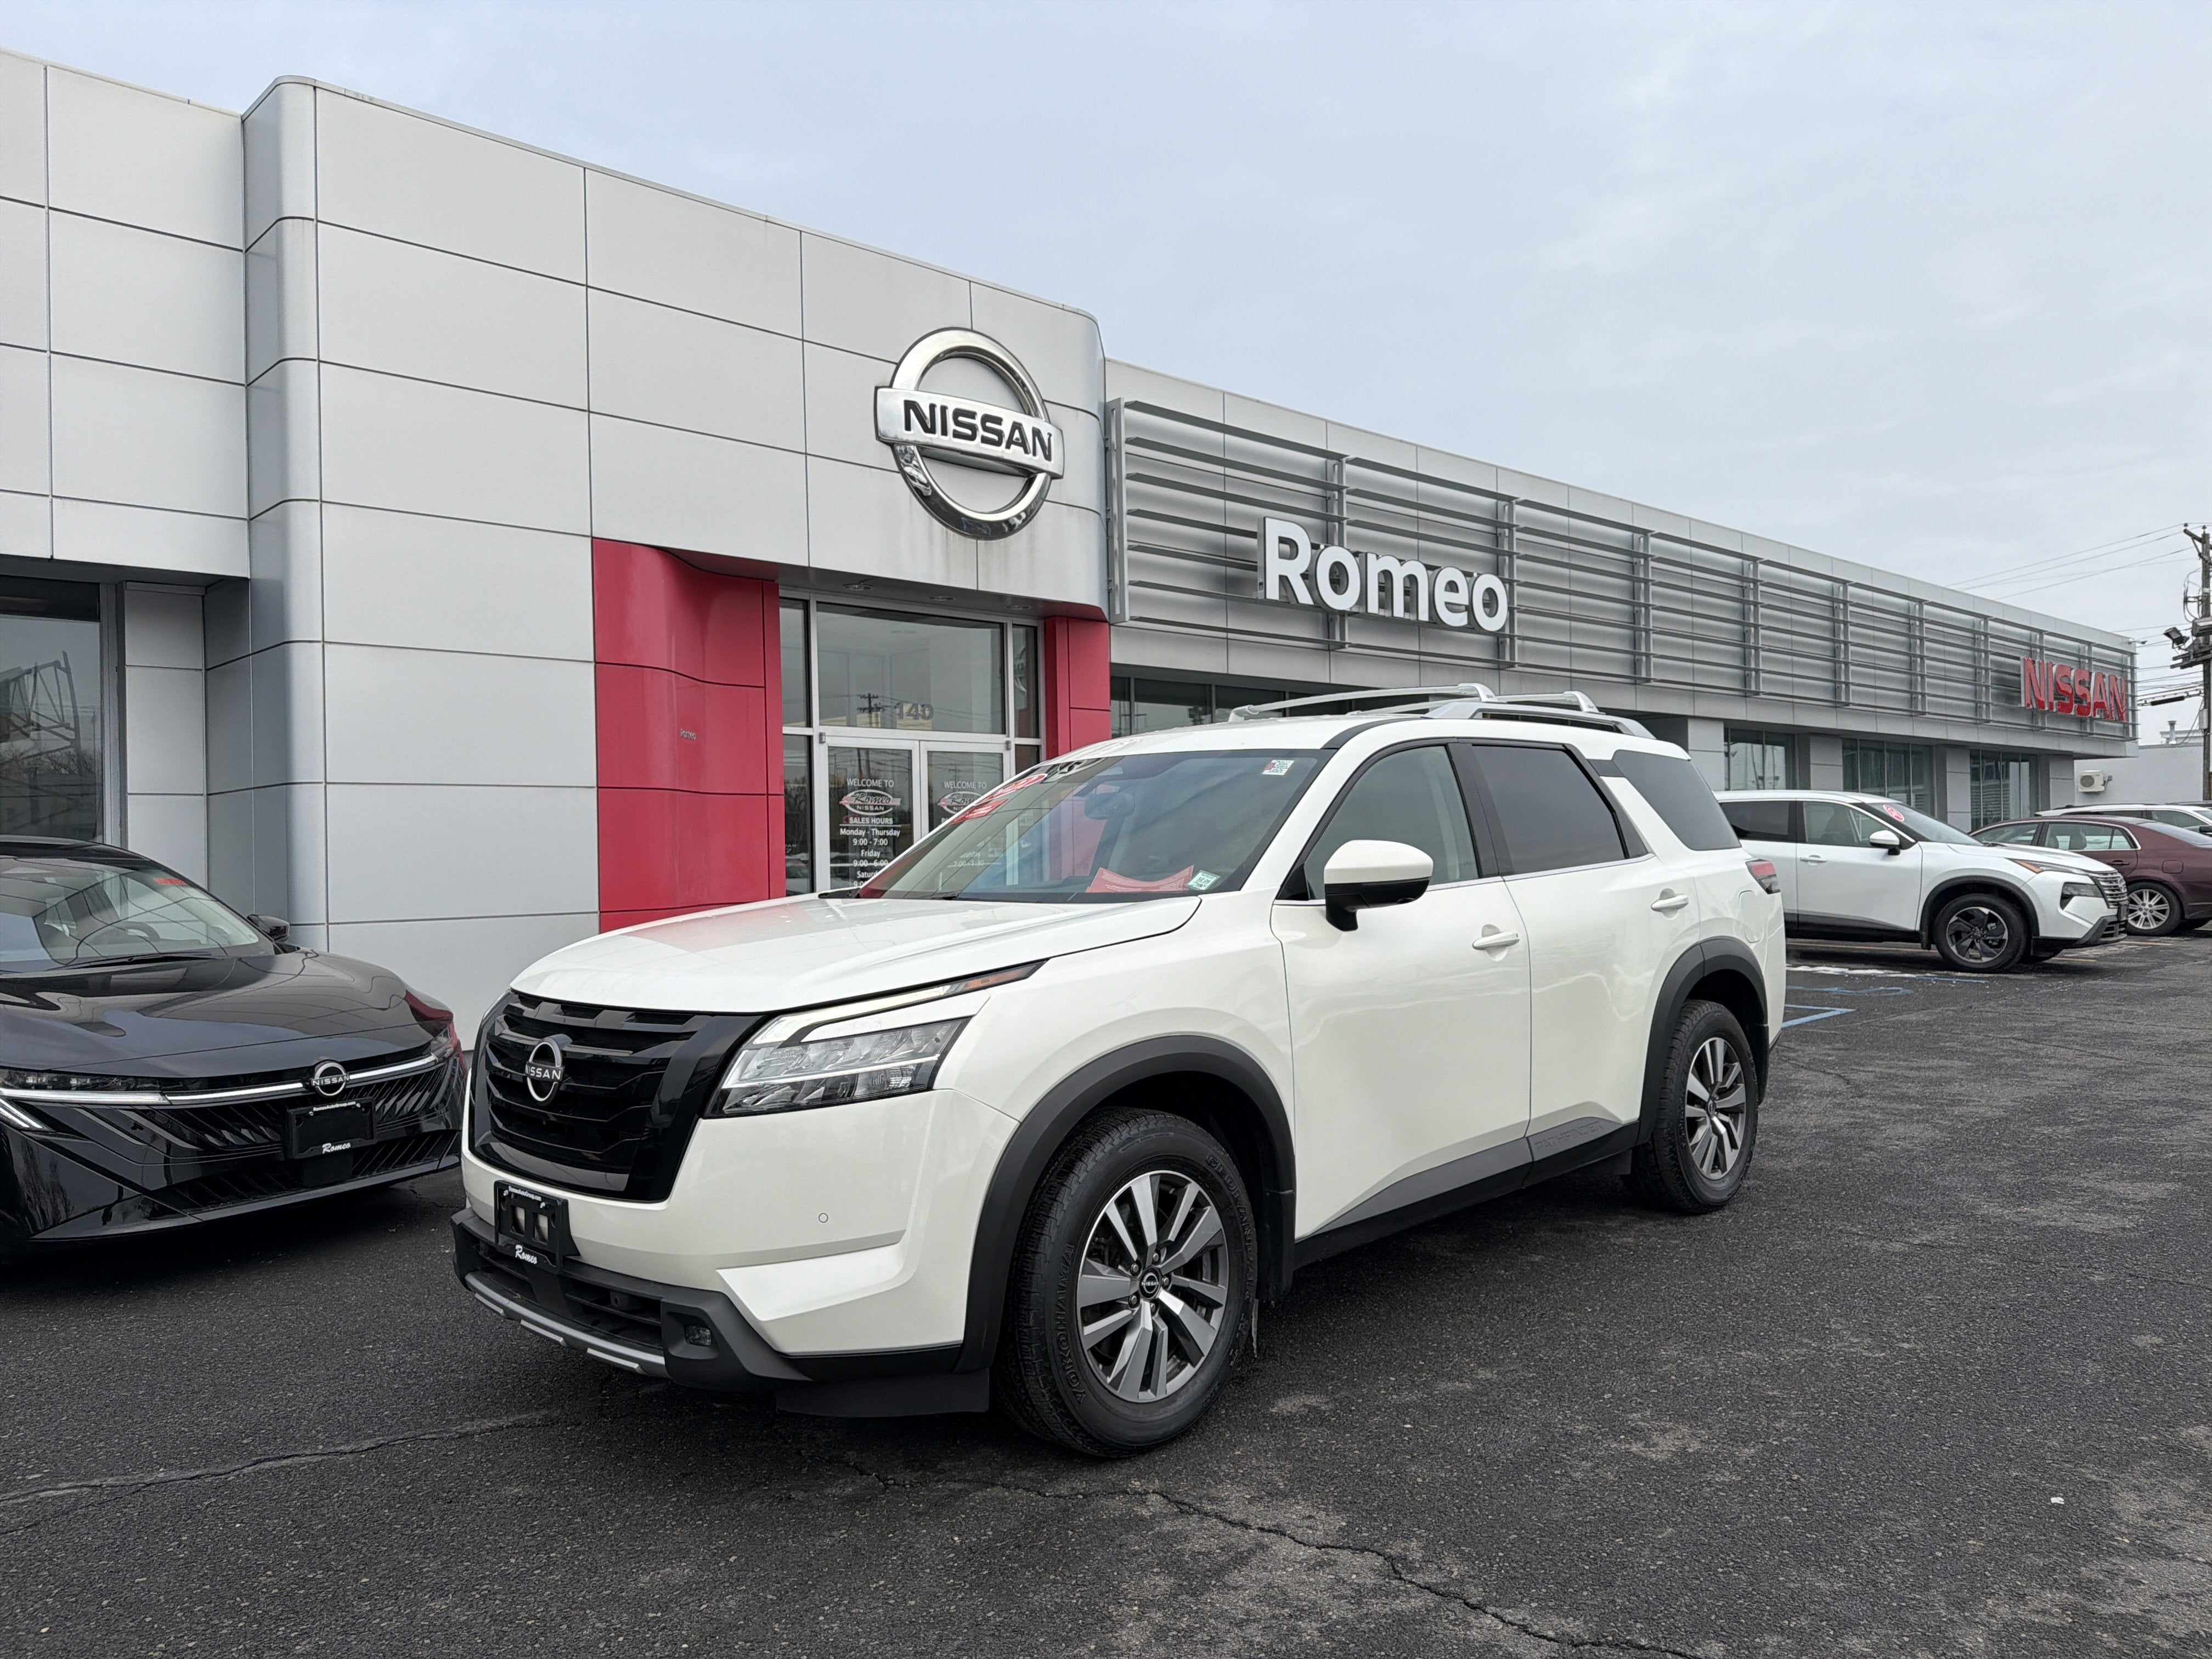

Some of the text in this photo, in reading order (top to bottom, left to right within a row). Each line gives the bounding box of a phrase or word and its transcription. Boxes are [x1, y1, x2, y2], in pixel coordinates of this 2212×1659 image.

[903, 399, 1052, 462] NISSAN
[1263, 516, 1509, 633] Romeo
[2022, 657, 2128, 723] NISSAN
[893, 702, 934, 720] 140
[847, 778, 882, 787] WELCOME
[851, 792, 891, 804] Romeo
[949, 794, 975, 804] Rom
[840, 828, 866, 837] Monday
[871, 828, 900, 837] Thursday
[861, 849, 881, 857] Friday
[524, 1064, 561, 1080] NISSAN
[312, 1075, 349, 1086] NISSAN
[322, 1143, 351, 1154] Romeo
[515, 1245, 538, 1264] Romeo
